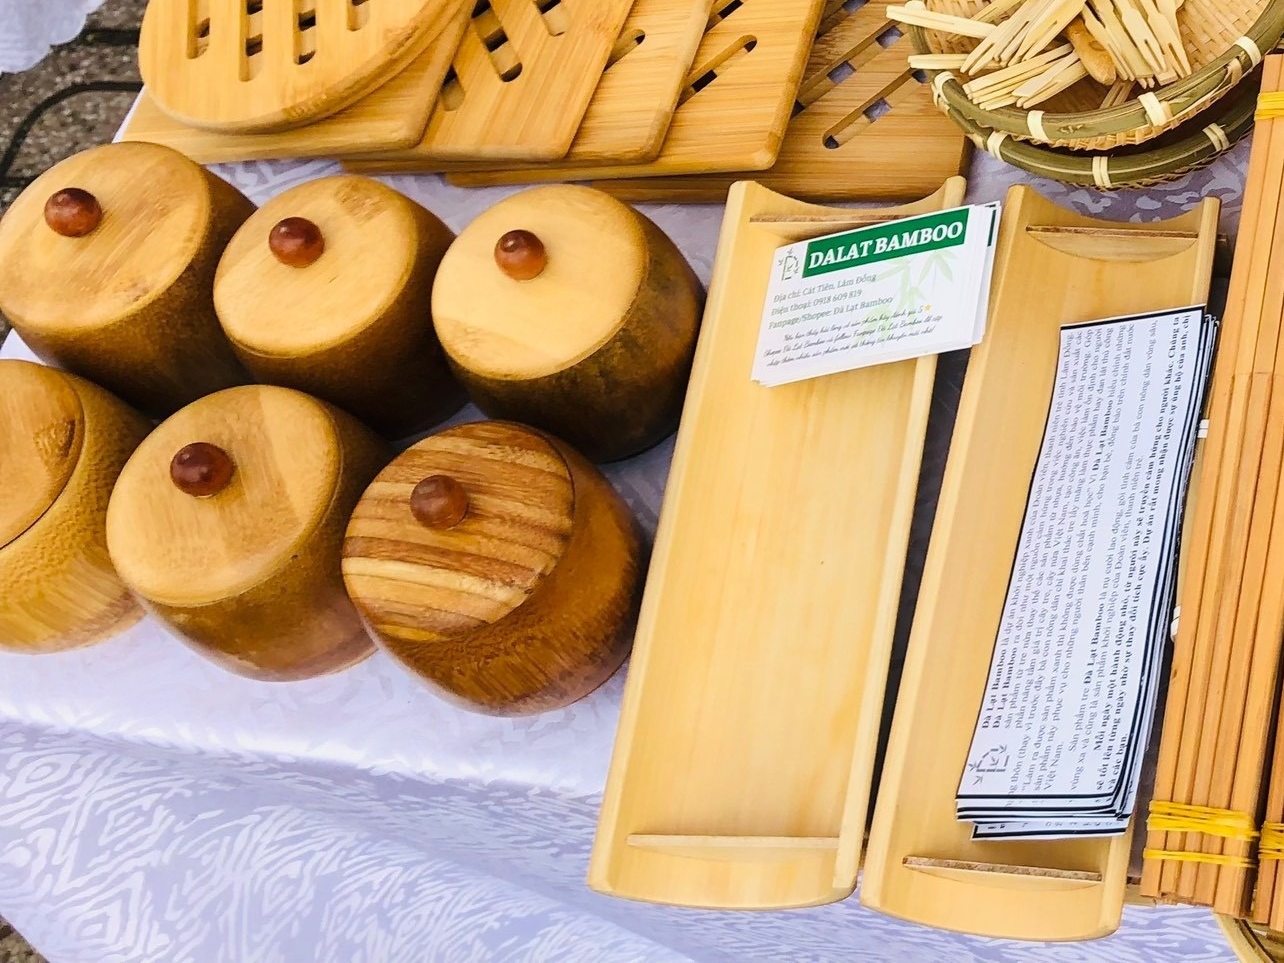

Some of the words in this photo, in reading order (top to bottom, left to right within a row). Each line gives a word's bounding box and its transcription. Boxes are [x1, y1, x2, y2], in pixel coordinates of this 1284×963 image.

[808, 239, 872, 268] DALAT
[873, 219, 963, 255] BAMBOO
[845, 301, 859, 314] Lạt
[859, 296, 893, 310] Bamboo
[1173, 316, 1179, 325] ta
[1126, 625, 1135, 647] thay
[1154, 467, 1164, 494] mong
